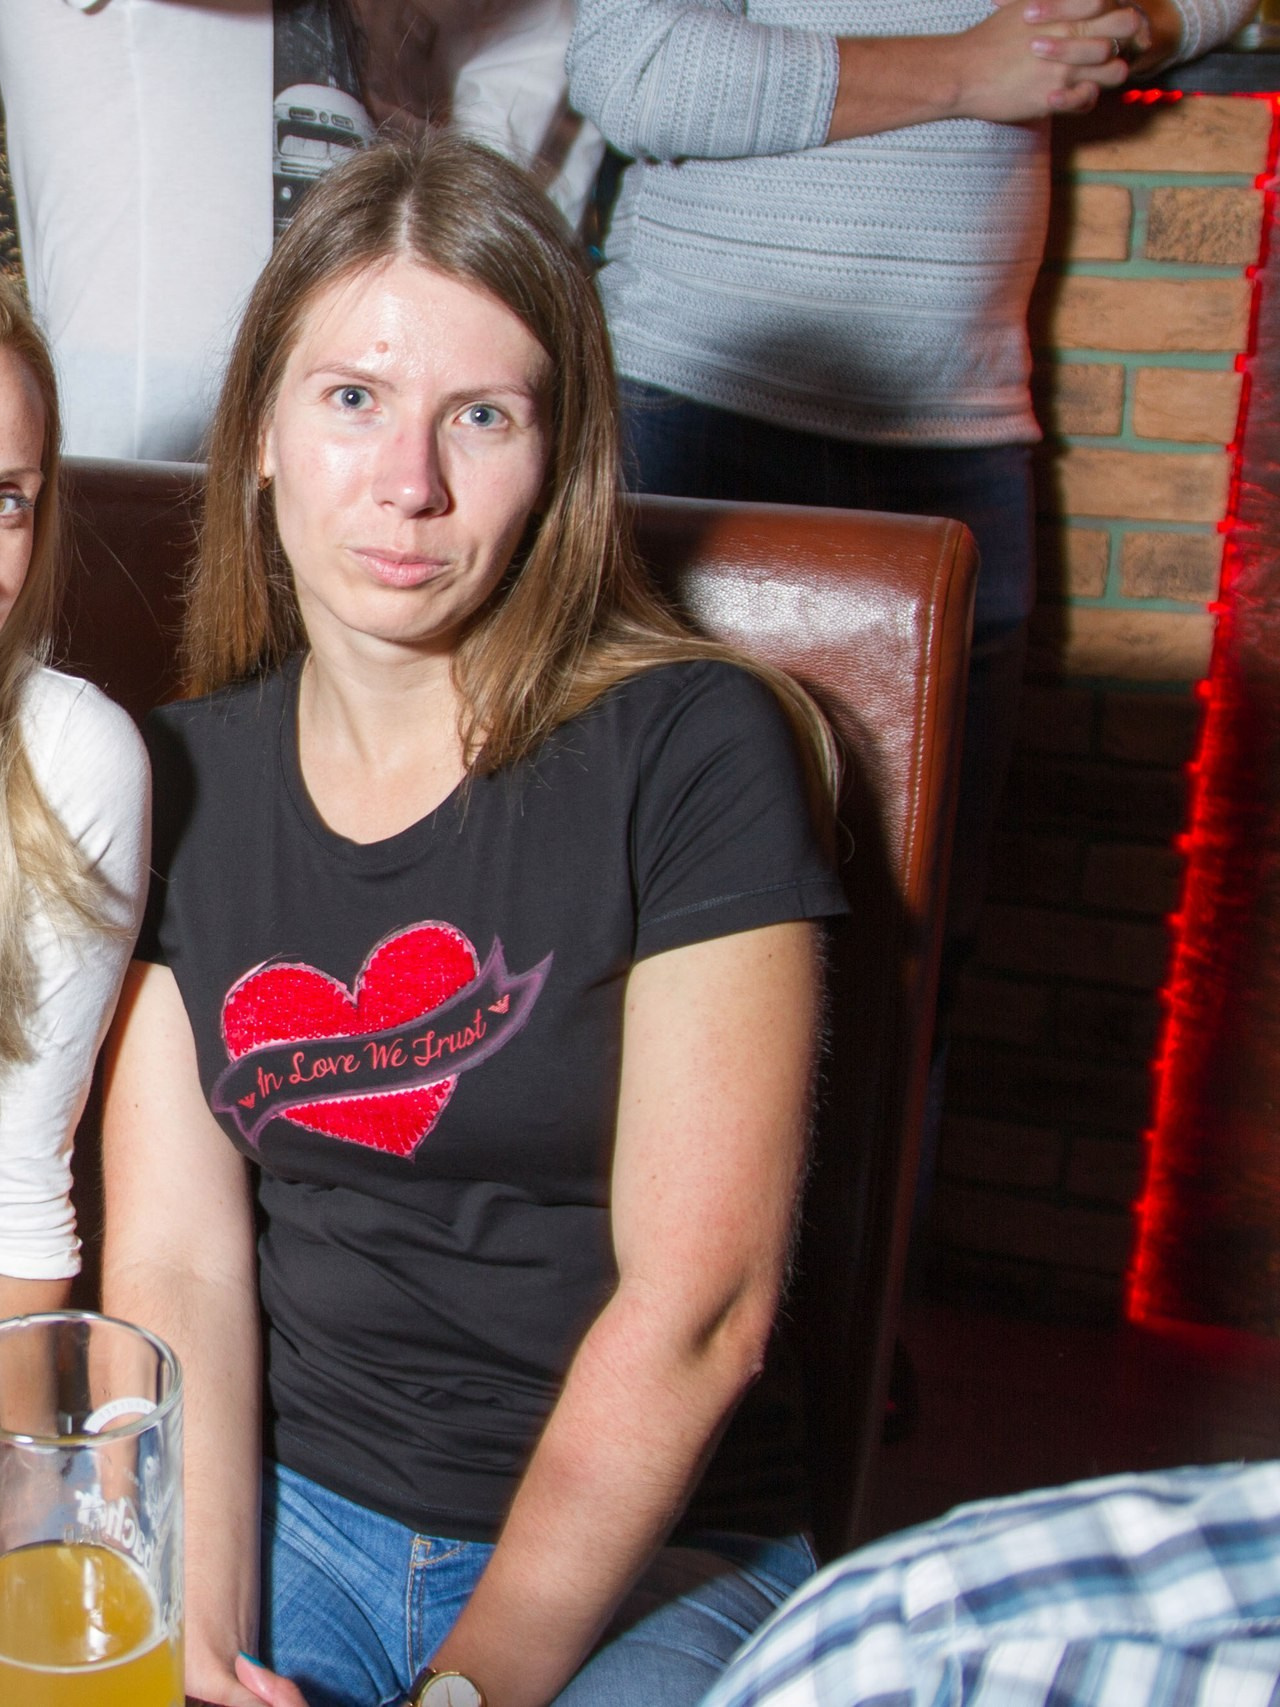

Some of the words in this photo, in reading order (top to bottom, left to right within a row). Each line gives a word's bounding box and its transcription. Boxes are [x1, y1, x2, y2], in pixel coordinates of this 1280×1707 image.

[258, 1066, 283, 1098] In
[288, 1052, 360, 1084] Love
[364, 1037, 408, 1070] We
[412, 1008, 486, 1066] Trust
